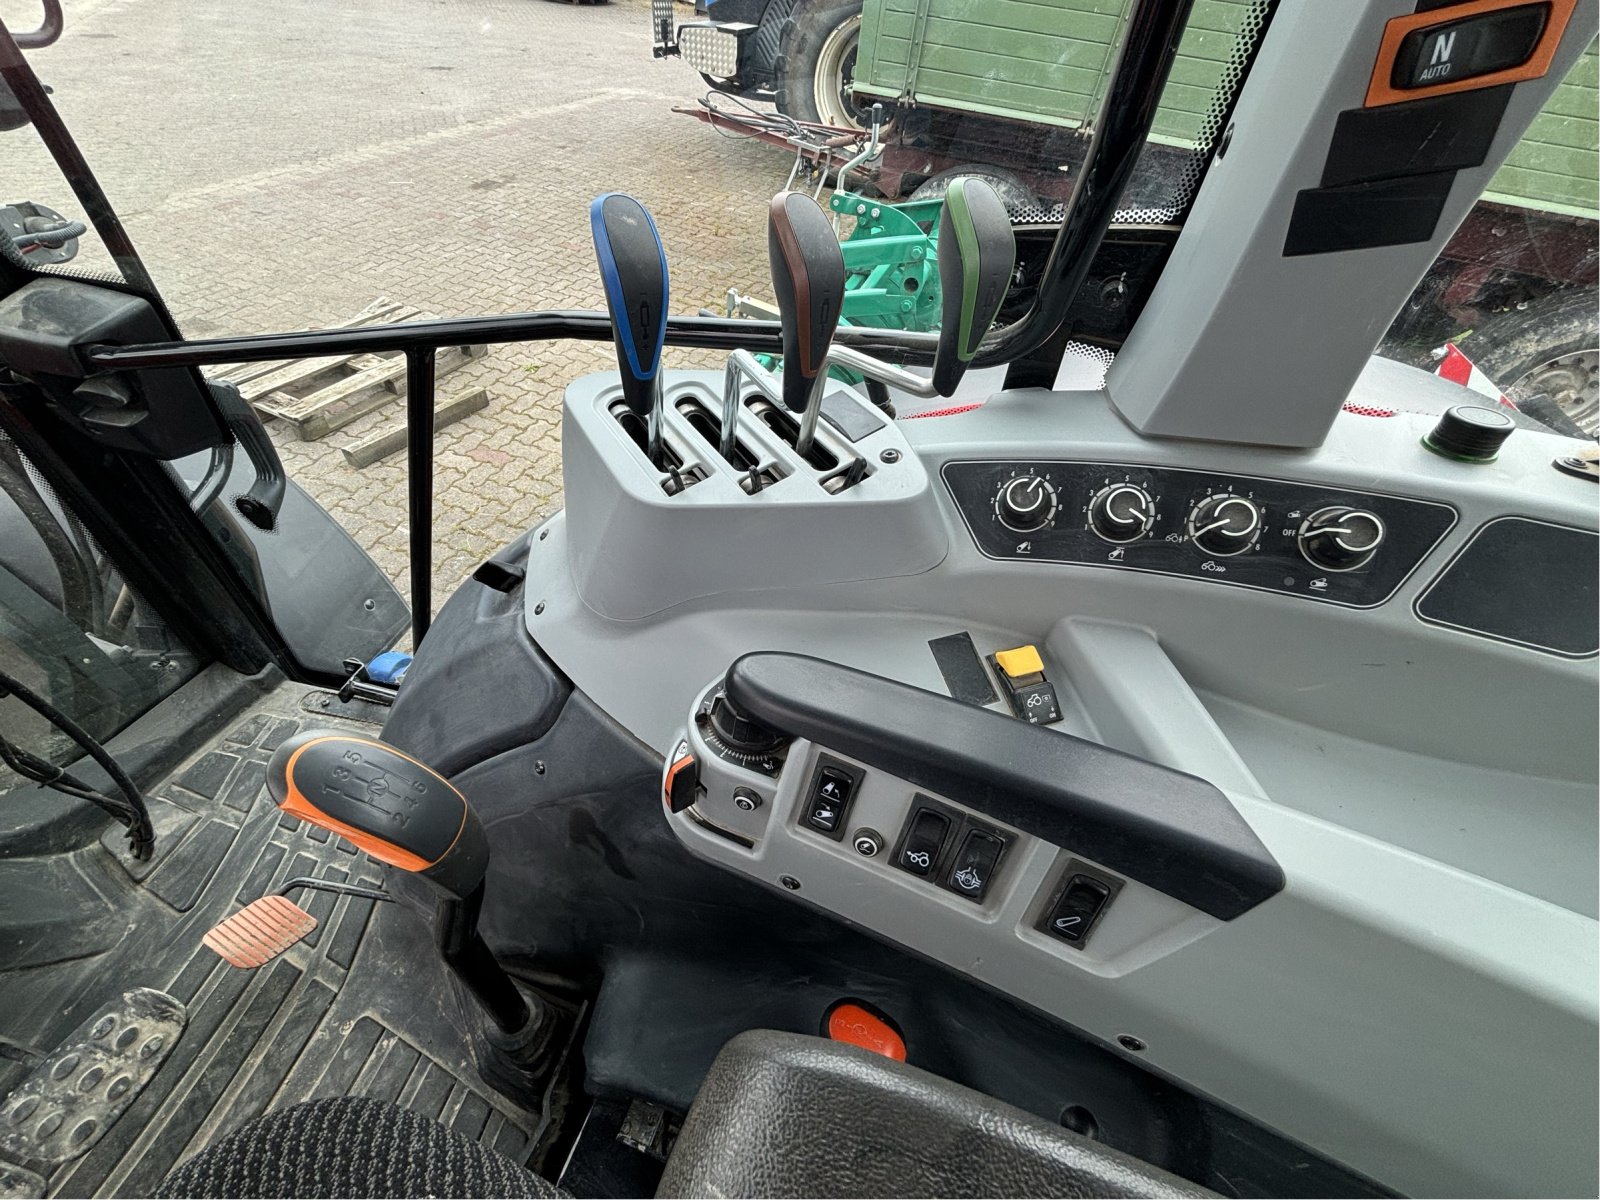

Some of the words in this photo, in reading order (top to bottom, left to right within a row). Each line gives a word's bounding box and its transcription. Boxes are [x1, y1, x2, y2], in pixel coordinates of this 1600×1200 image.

[1430, 31, 1457, 65] N
[1419, 63, 1451, 82] AUTO
[1282, 528, 1296, 537] OFF
